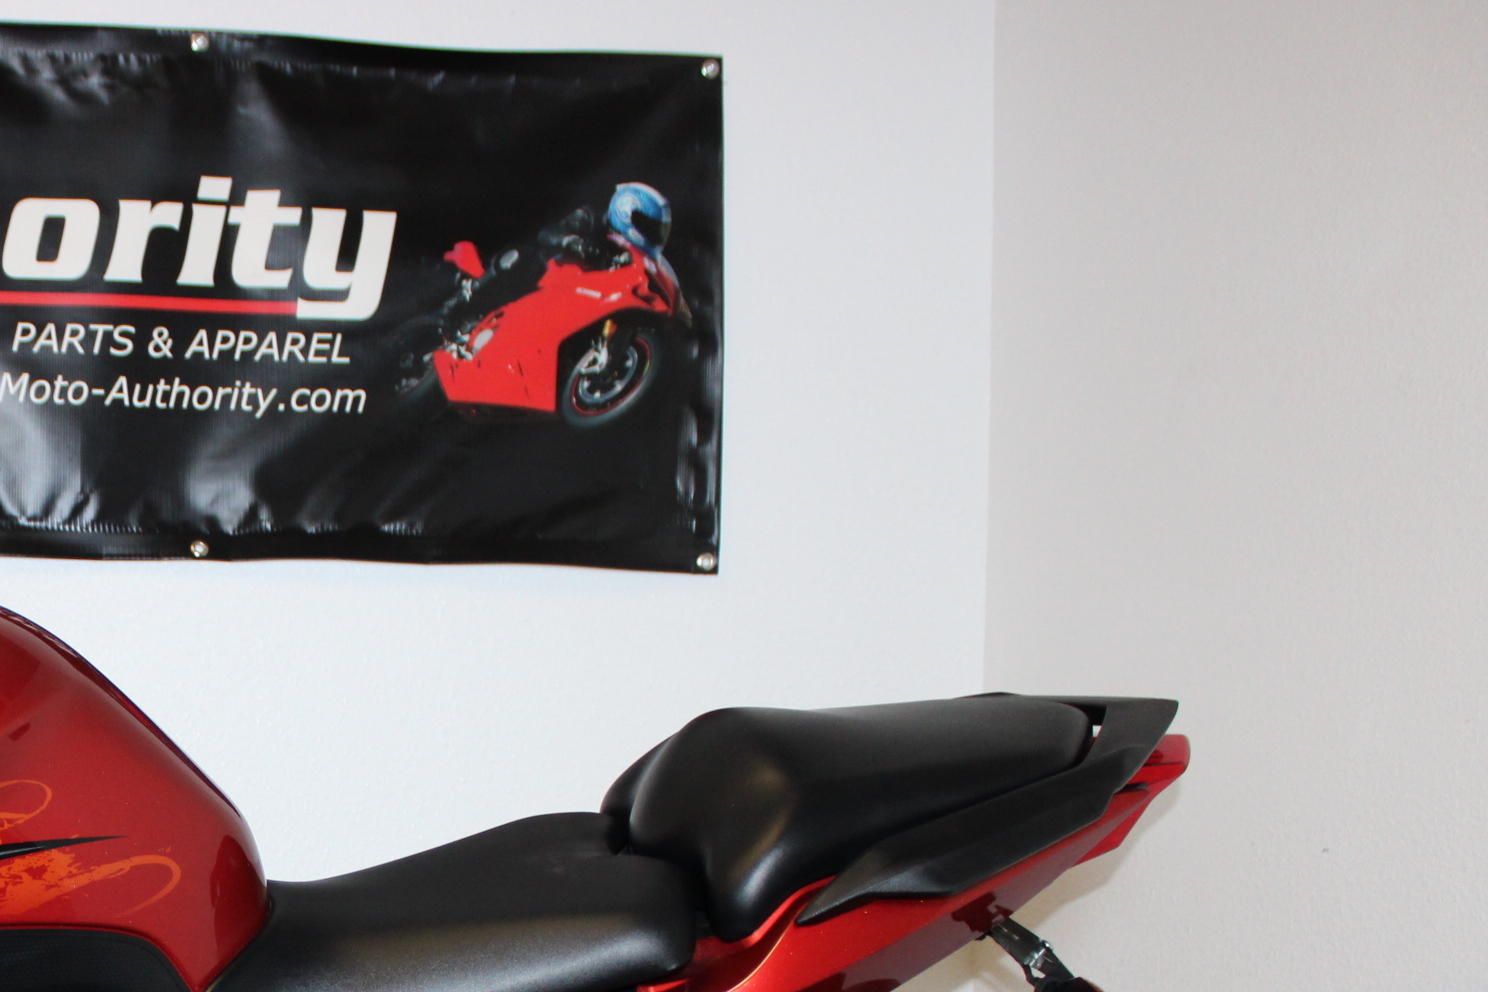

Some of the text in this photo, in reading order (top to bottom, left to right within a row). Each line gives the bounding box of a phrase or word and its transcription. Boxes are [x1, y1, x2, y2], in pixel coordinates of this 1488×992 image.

[11, 321, 136, 357] PARTS
[147, 326, 174, 360] &
[185, 328, 351, 365] APPAREL
